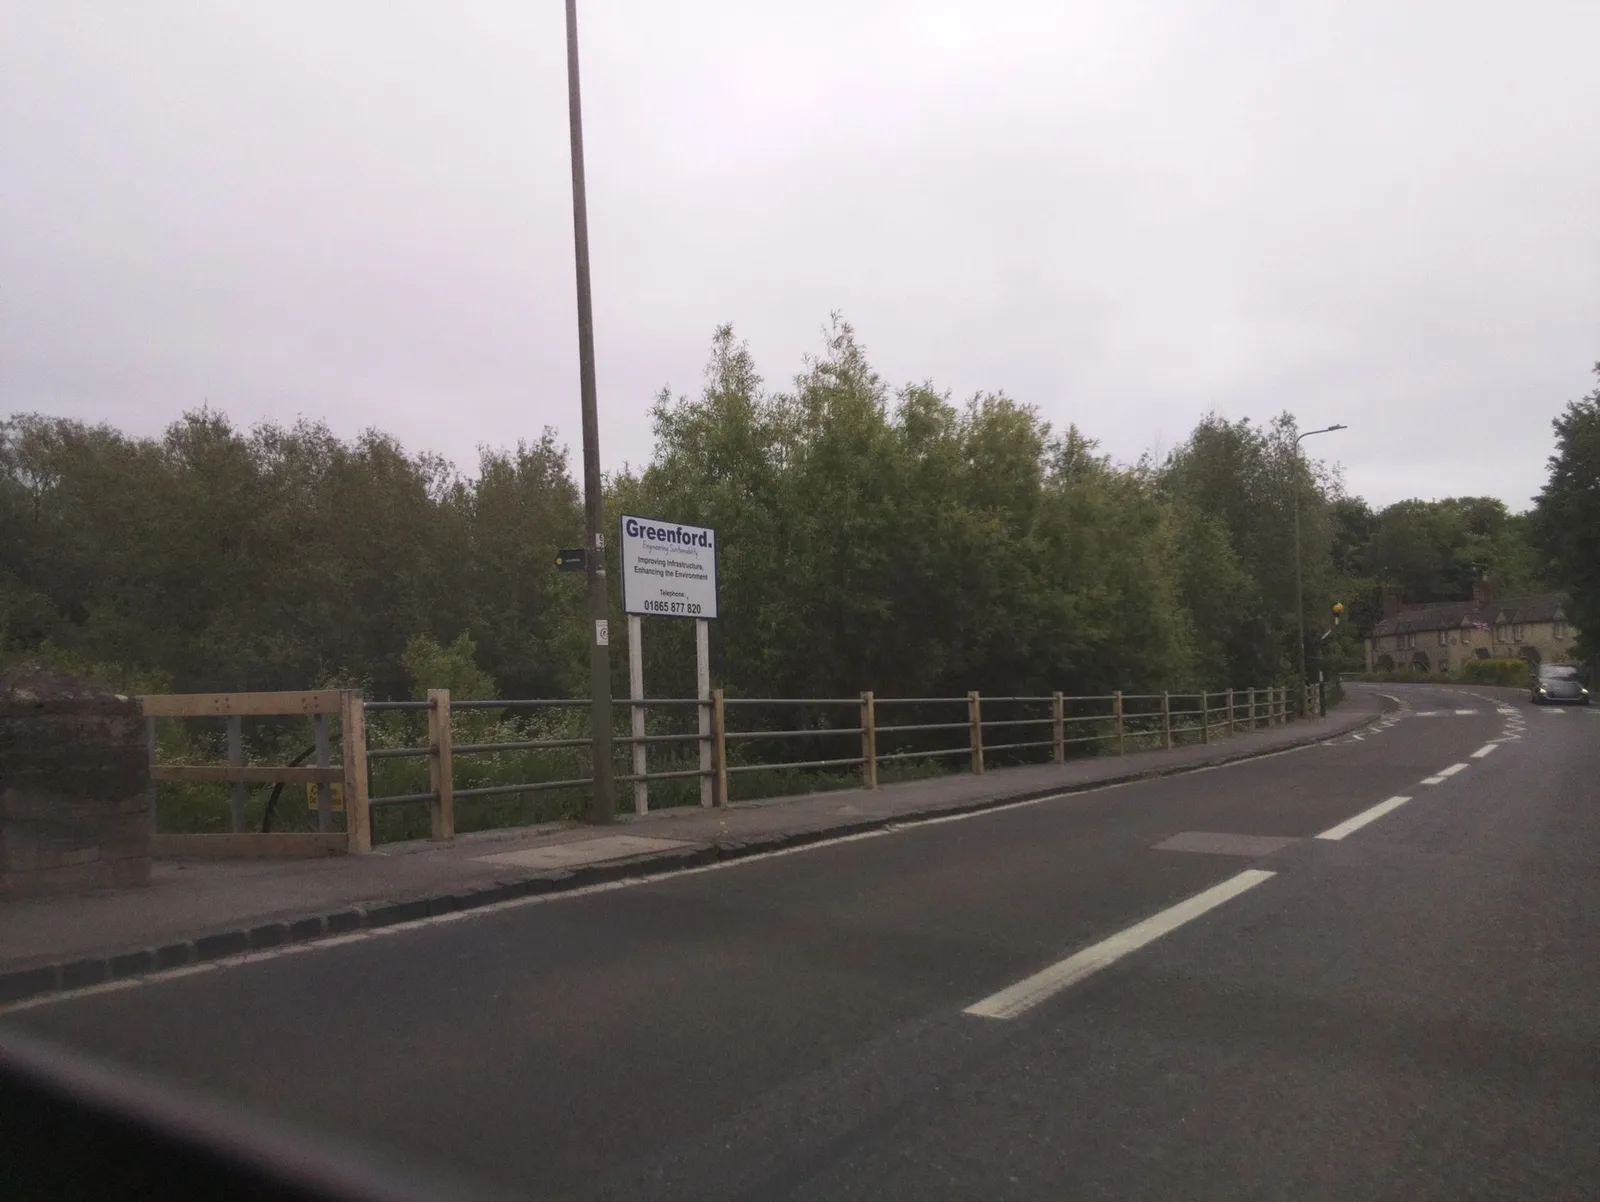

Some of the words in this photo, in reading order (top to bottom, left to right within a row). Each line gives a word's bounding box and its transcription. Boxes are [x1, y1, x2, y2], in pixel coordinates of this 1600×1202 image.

[626, 518, 712, 548] Greenford.
[638, 556, 666, 567] Improving
[634, 566, 663, 577] Enhancing
[675, 570, 708, 580] Environment
[644, 600, 668, 611] 01865
[671, 602, 685, 612] 877
[687, 603, 701, 614] 820
